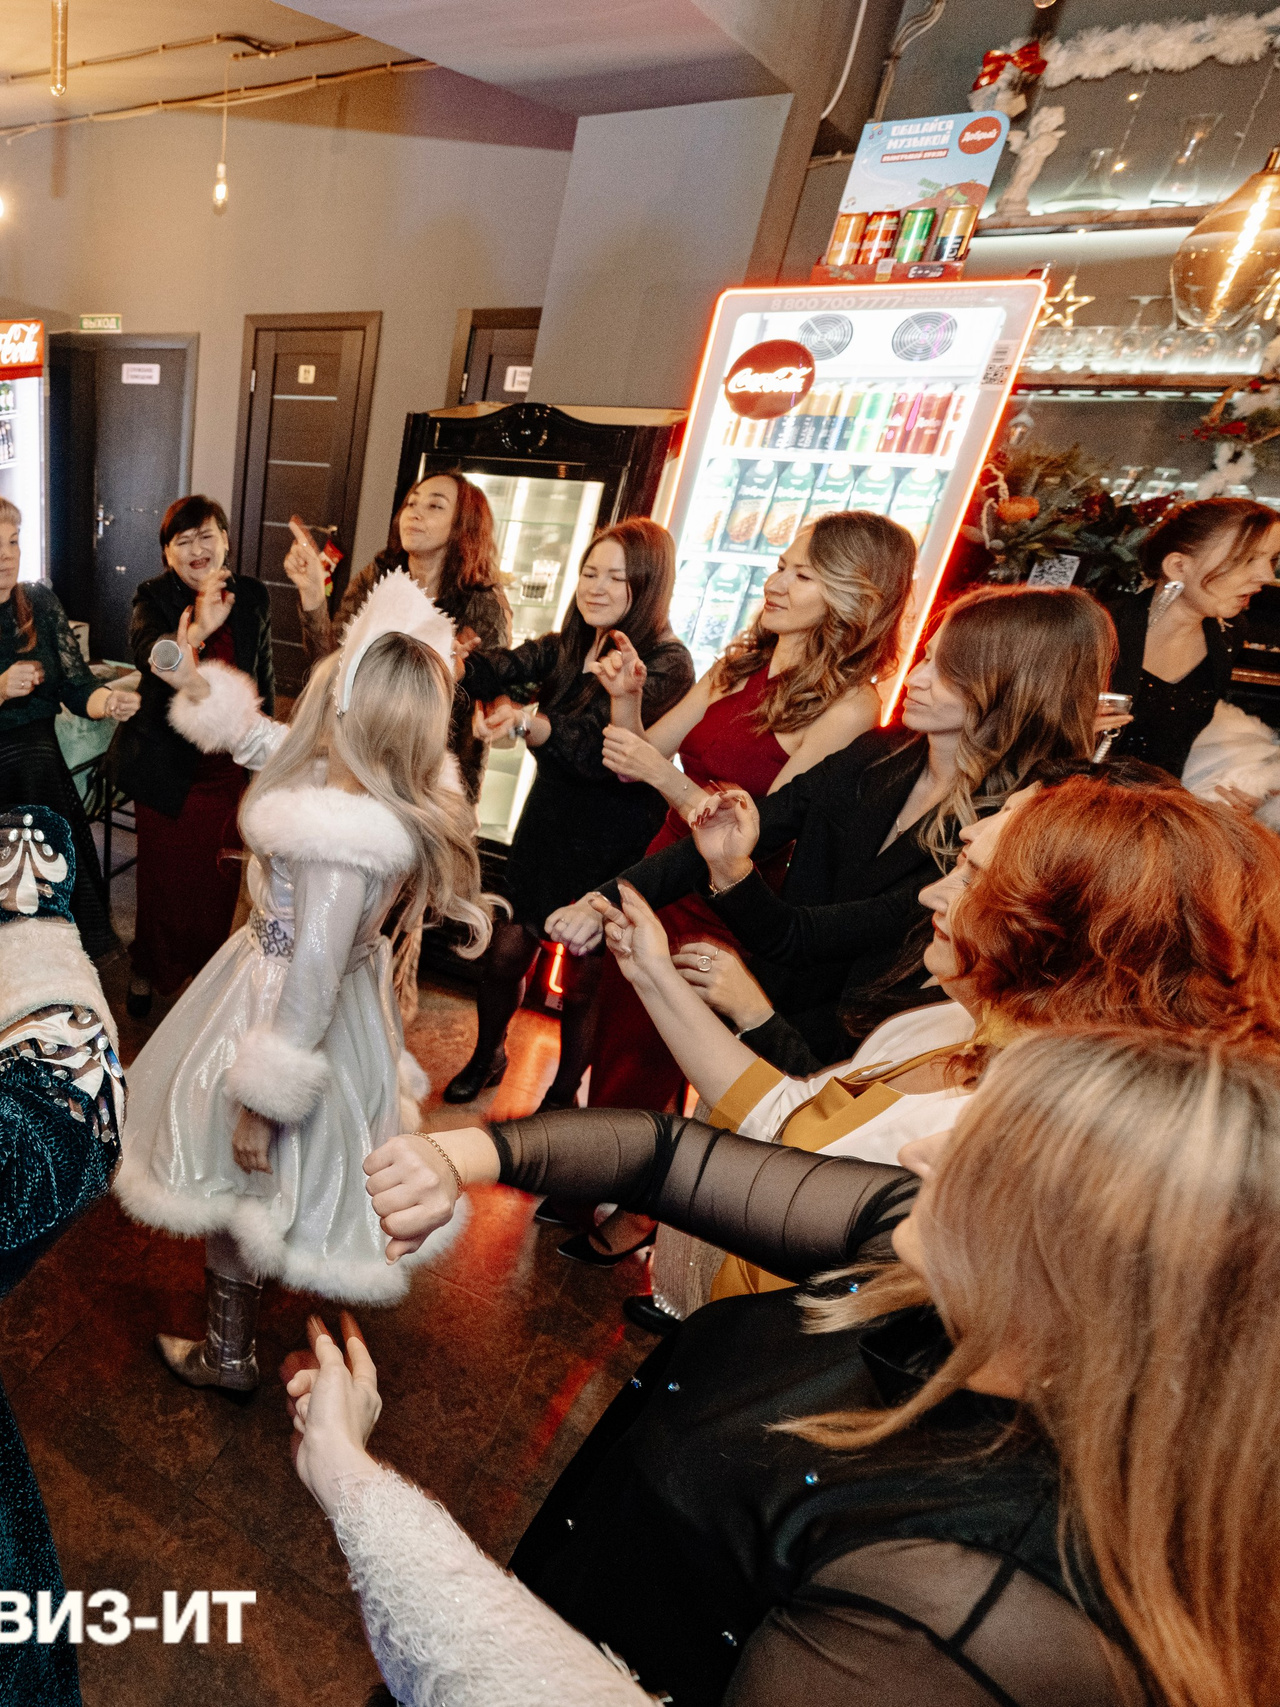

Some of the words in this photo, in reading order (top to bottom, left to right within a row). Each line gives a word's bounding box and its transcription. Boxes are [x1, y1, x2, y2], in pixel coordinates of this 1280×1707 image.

[886, 131, 952, 150] МУЗЫКОЙ
[770, 298, 782, 310] 8
[783, 297, 819, 310] 800
[819, 296, 856, 310] 700
[857, 295, 903, 309] 7777
[82, 317, 117, 329] ВЫХОД
